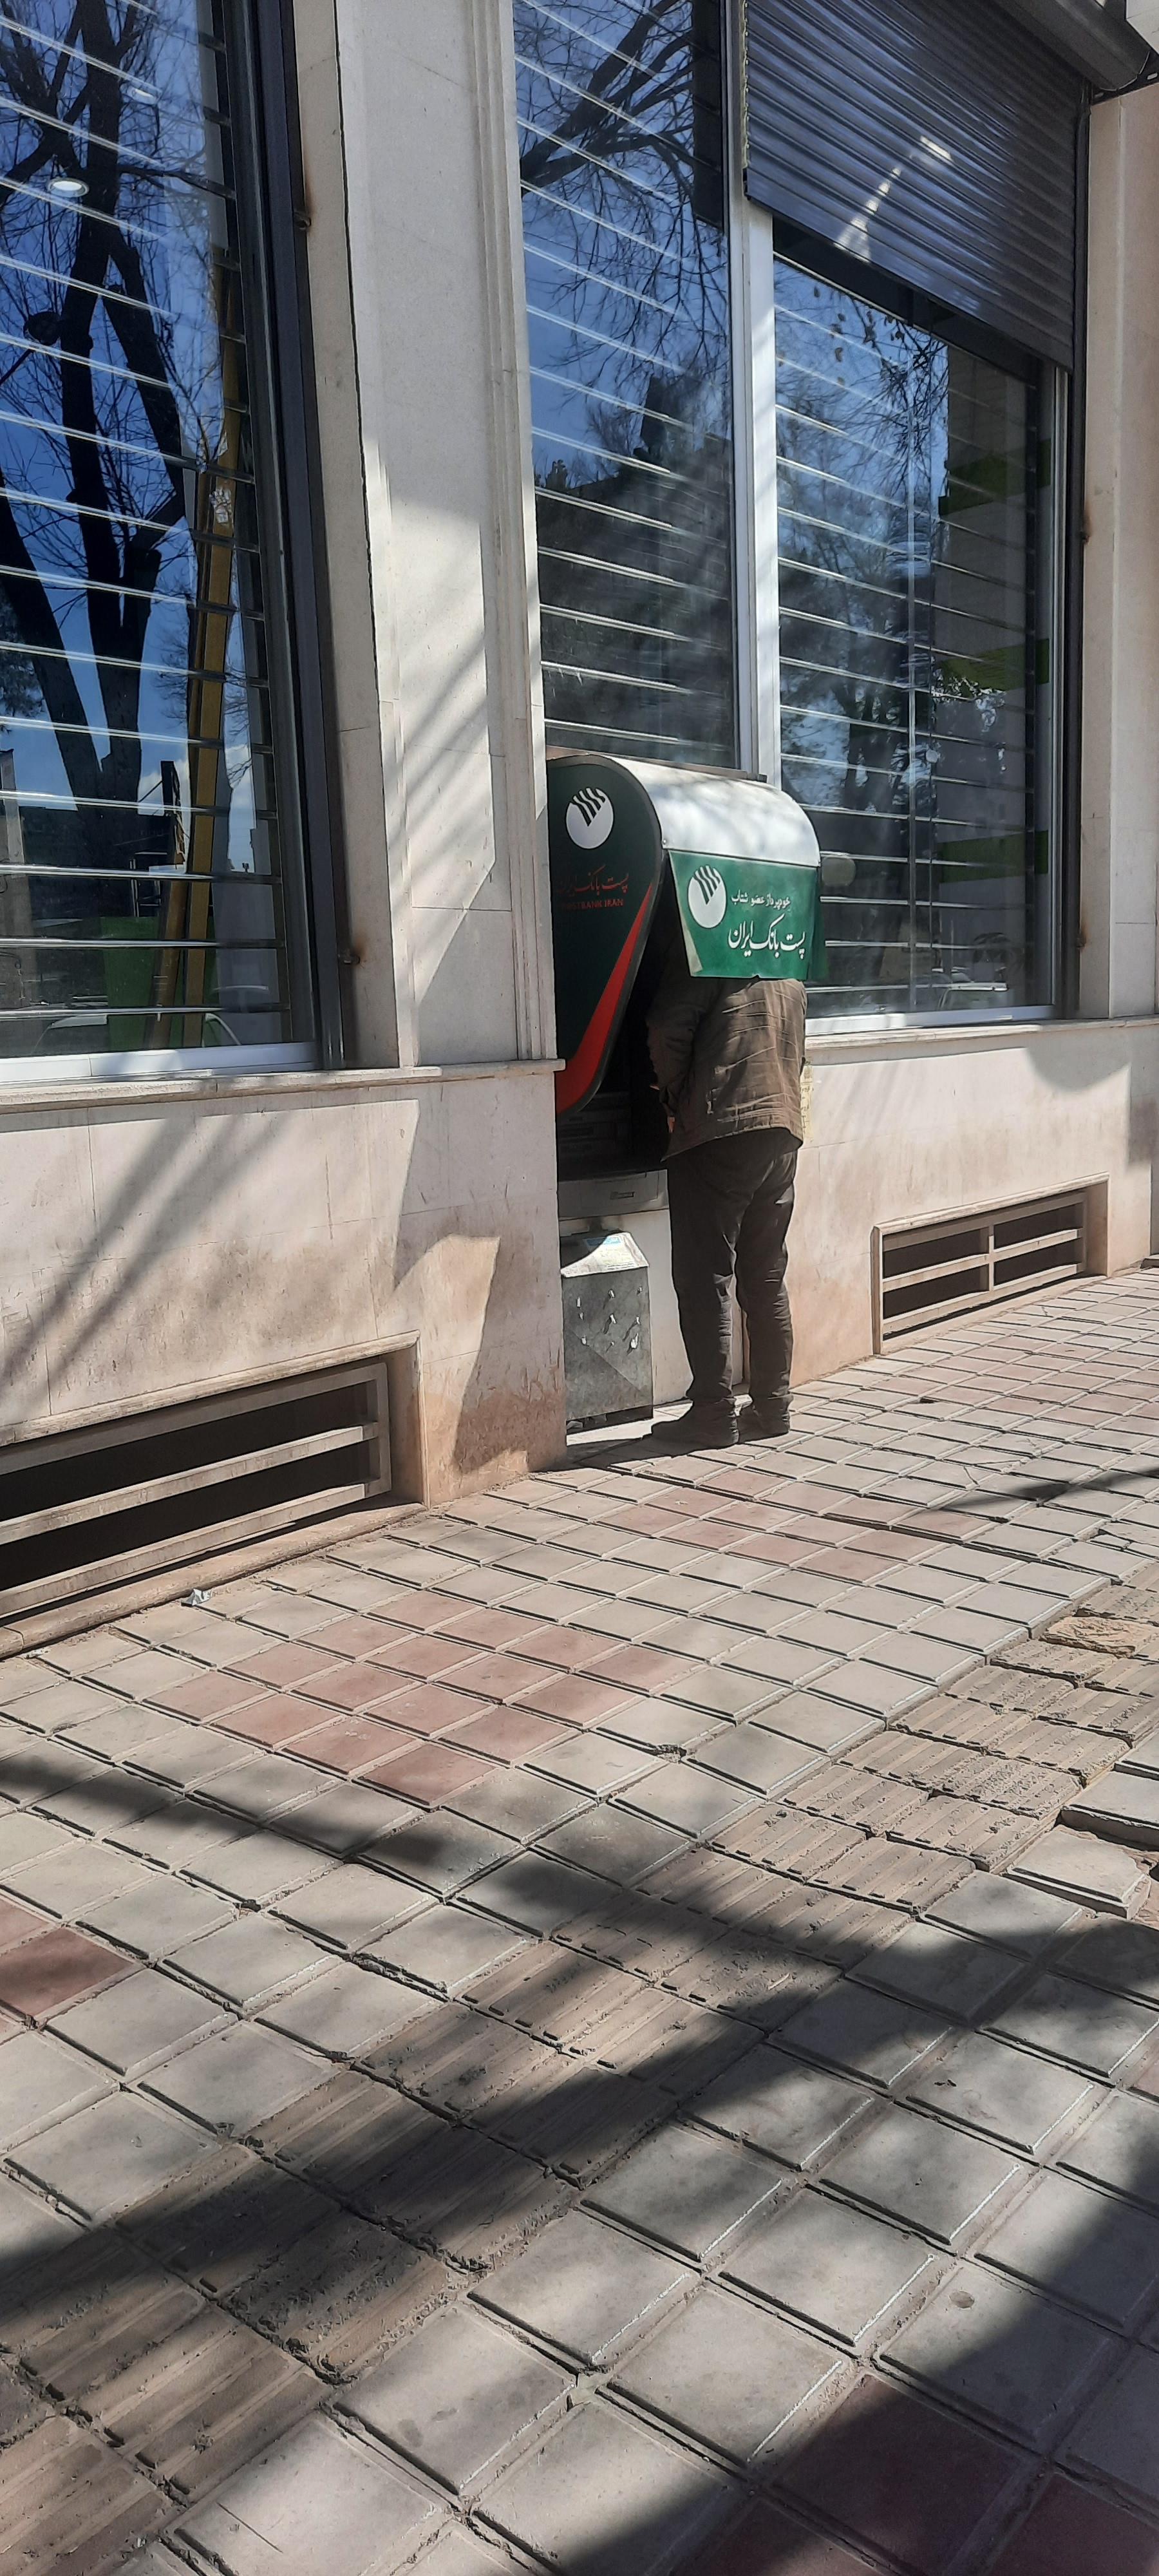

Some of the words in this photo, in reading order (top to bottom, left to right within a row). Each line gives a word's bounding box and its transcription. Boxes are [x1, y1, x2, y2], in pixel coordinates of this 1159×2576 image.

[601, 873, 629, 894] پست
[604, 898, 624, 907] IRAN
[731, 889, 748, 905] شتاب
[751, 895, 766, 906] عضو
[728, 920, 754, 957] ایران
[749, 913, 786, 958] بانک
[780, 931, 806, 960] پست
